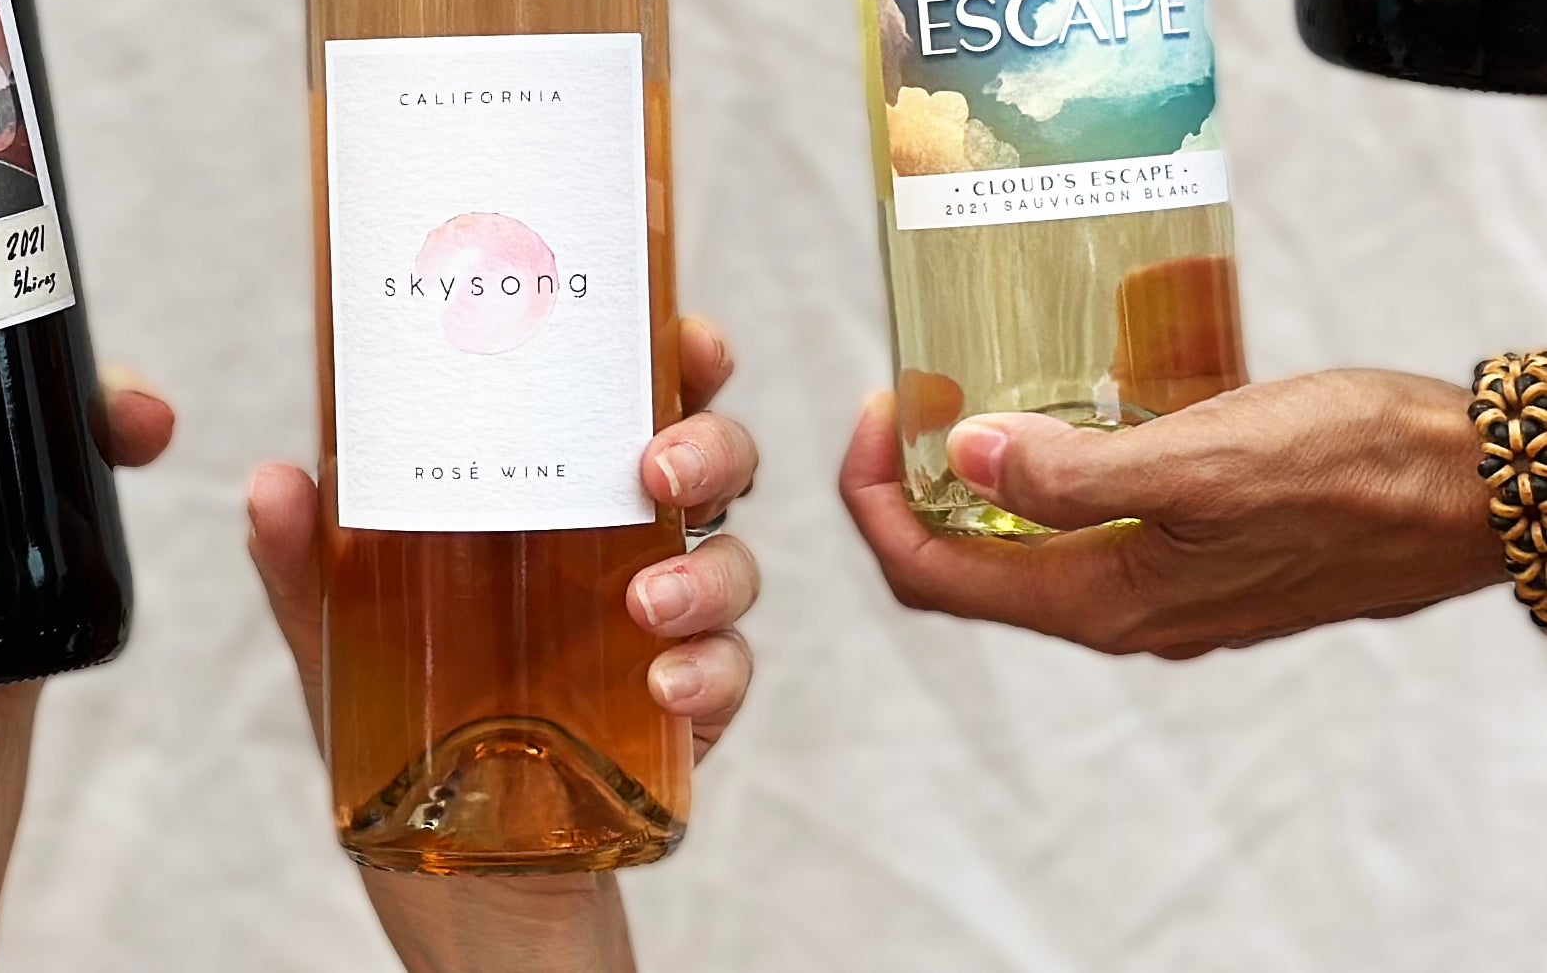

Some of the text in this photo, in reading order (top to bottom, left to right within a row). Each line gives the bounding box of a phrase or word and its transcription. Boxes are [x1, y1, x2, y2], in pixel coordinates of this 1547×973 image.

[399, 90, 562, 106] CALIFORNIA
[973, 164, 1174, 196] CLOUD'S ESCAPE
[945, 183, 1199, 216] 2021 SAUVIGNON BLANC
[7, 225, 44, 260] 2021
[14, 266, 56, 298] Shiraz
[384, 272, 588, 301] skysong
[415, 462, 567, 480] ROSÉ WINE
